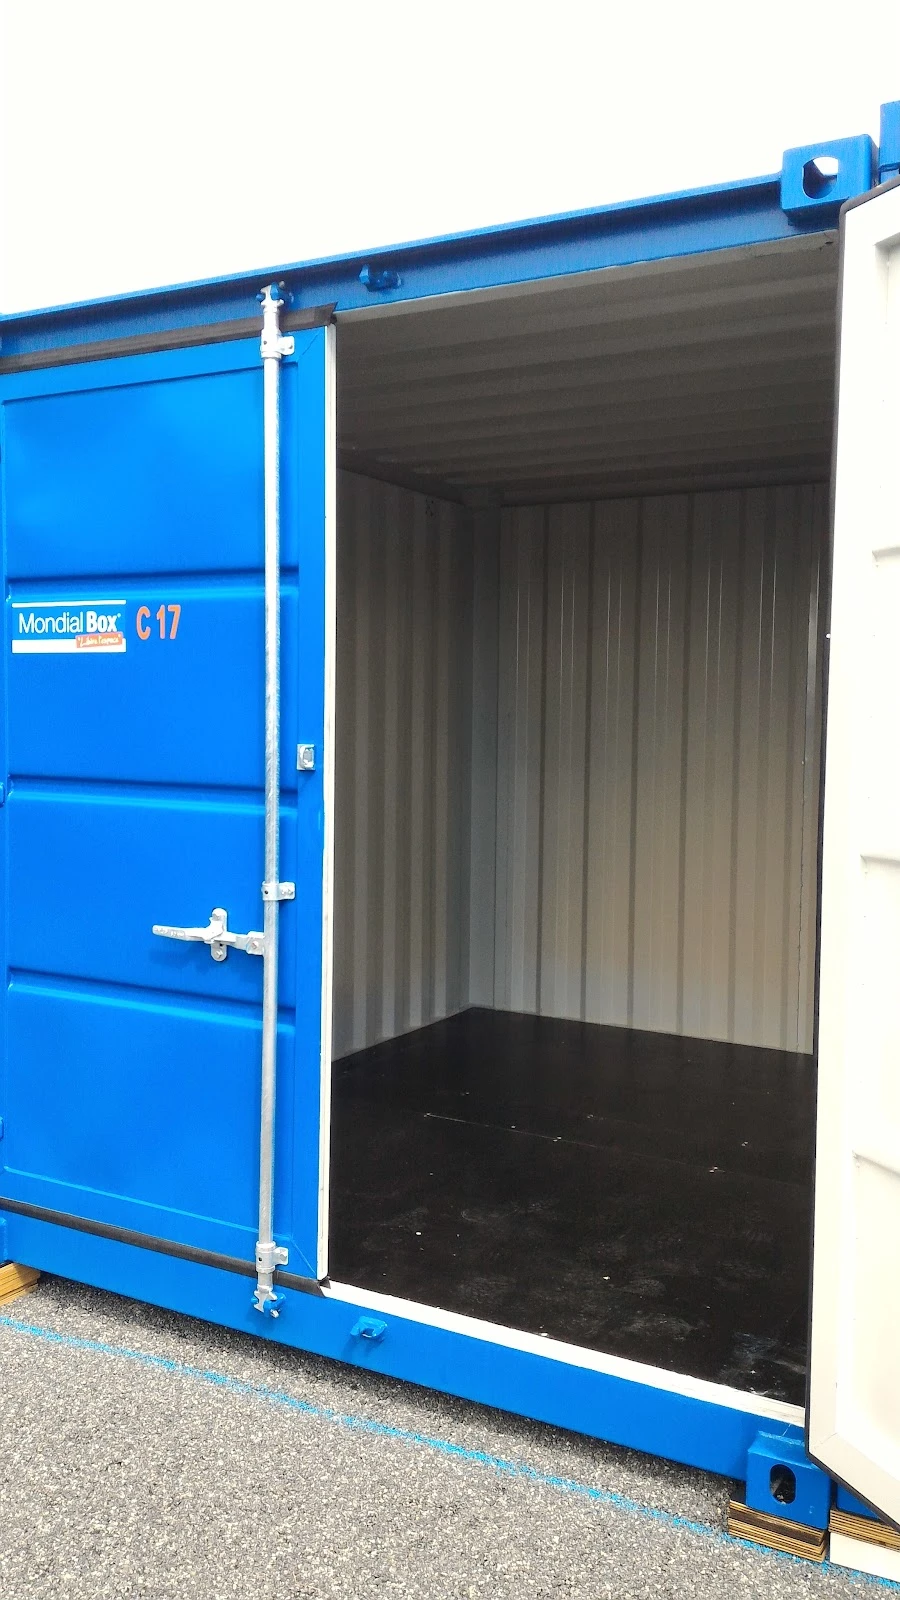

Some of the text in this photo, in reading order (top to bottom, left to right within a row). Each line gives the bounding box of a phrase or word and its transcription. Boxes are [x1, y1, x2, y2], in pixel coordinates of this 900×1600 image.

[18, 610, 118, 634] Mondial Box
[136, 604, 181, 640] C 17
